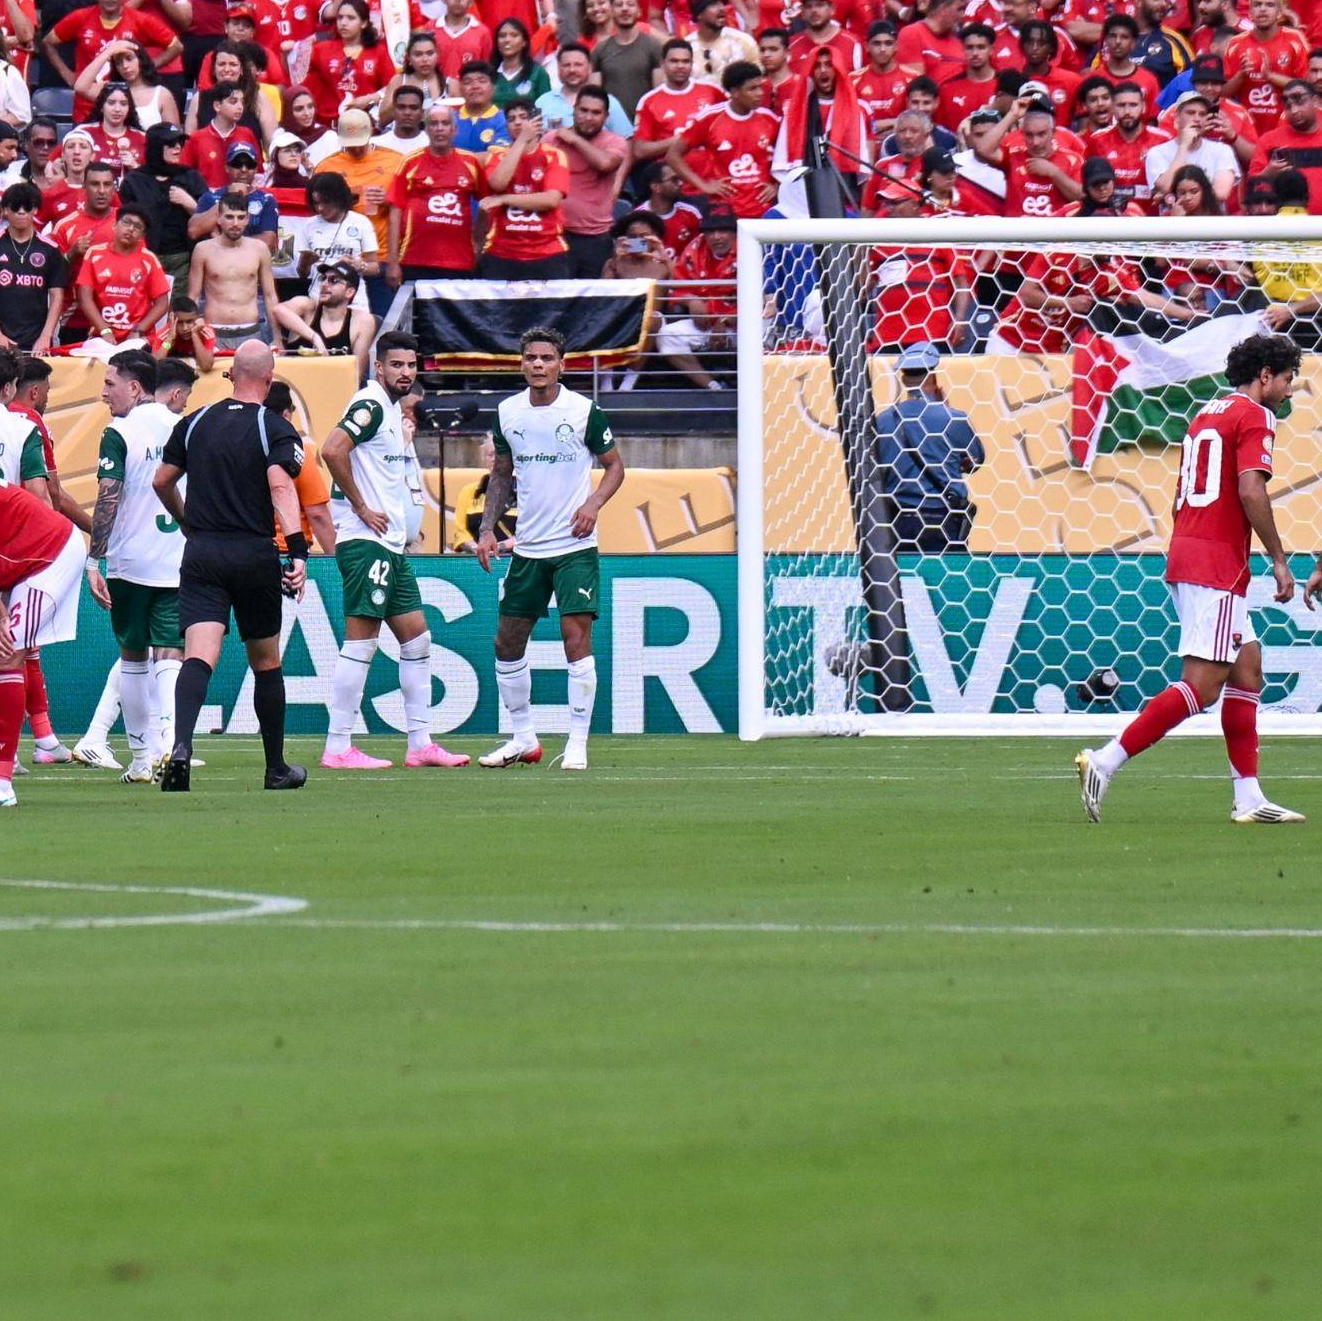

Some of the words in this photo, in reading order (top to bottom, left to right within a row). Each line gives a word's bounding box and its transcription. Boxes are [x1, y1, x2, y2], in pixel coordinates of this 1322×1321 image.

[15, 274, 44, 287] XBTO
[368, 559, 391, 586] 42
[200, 576, 724, 734] ASR
